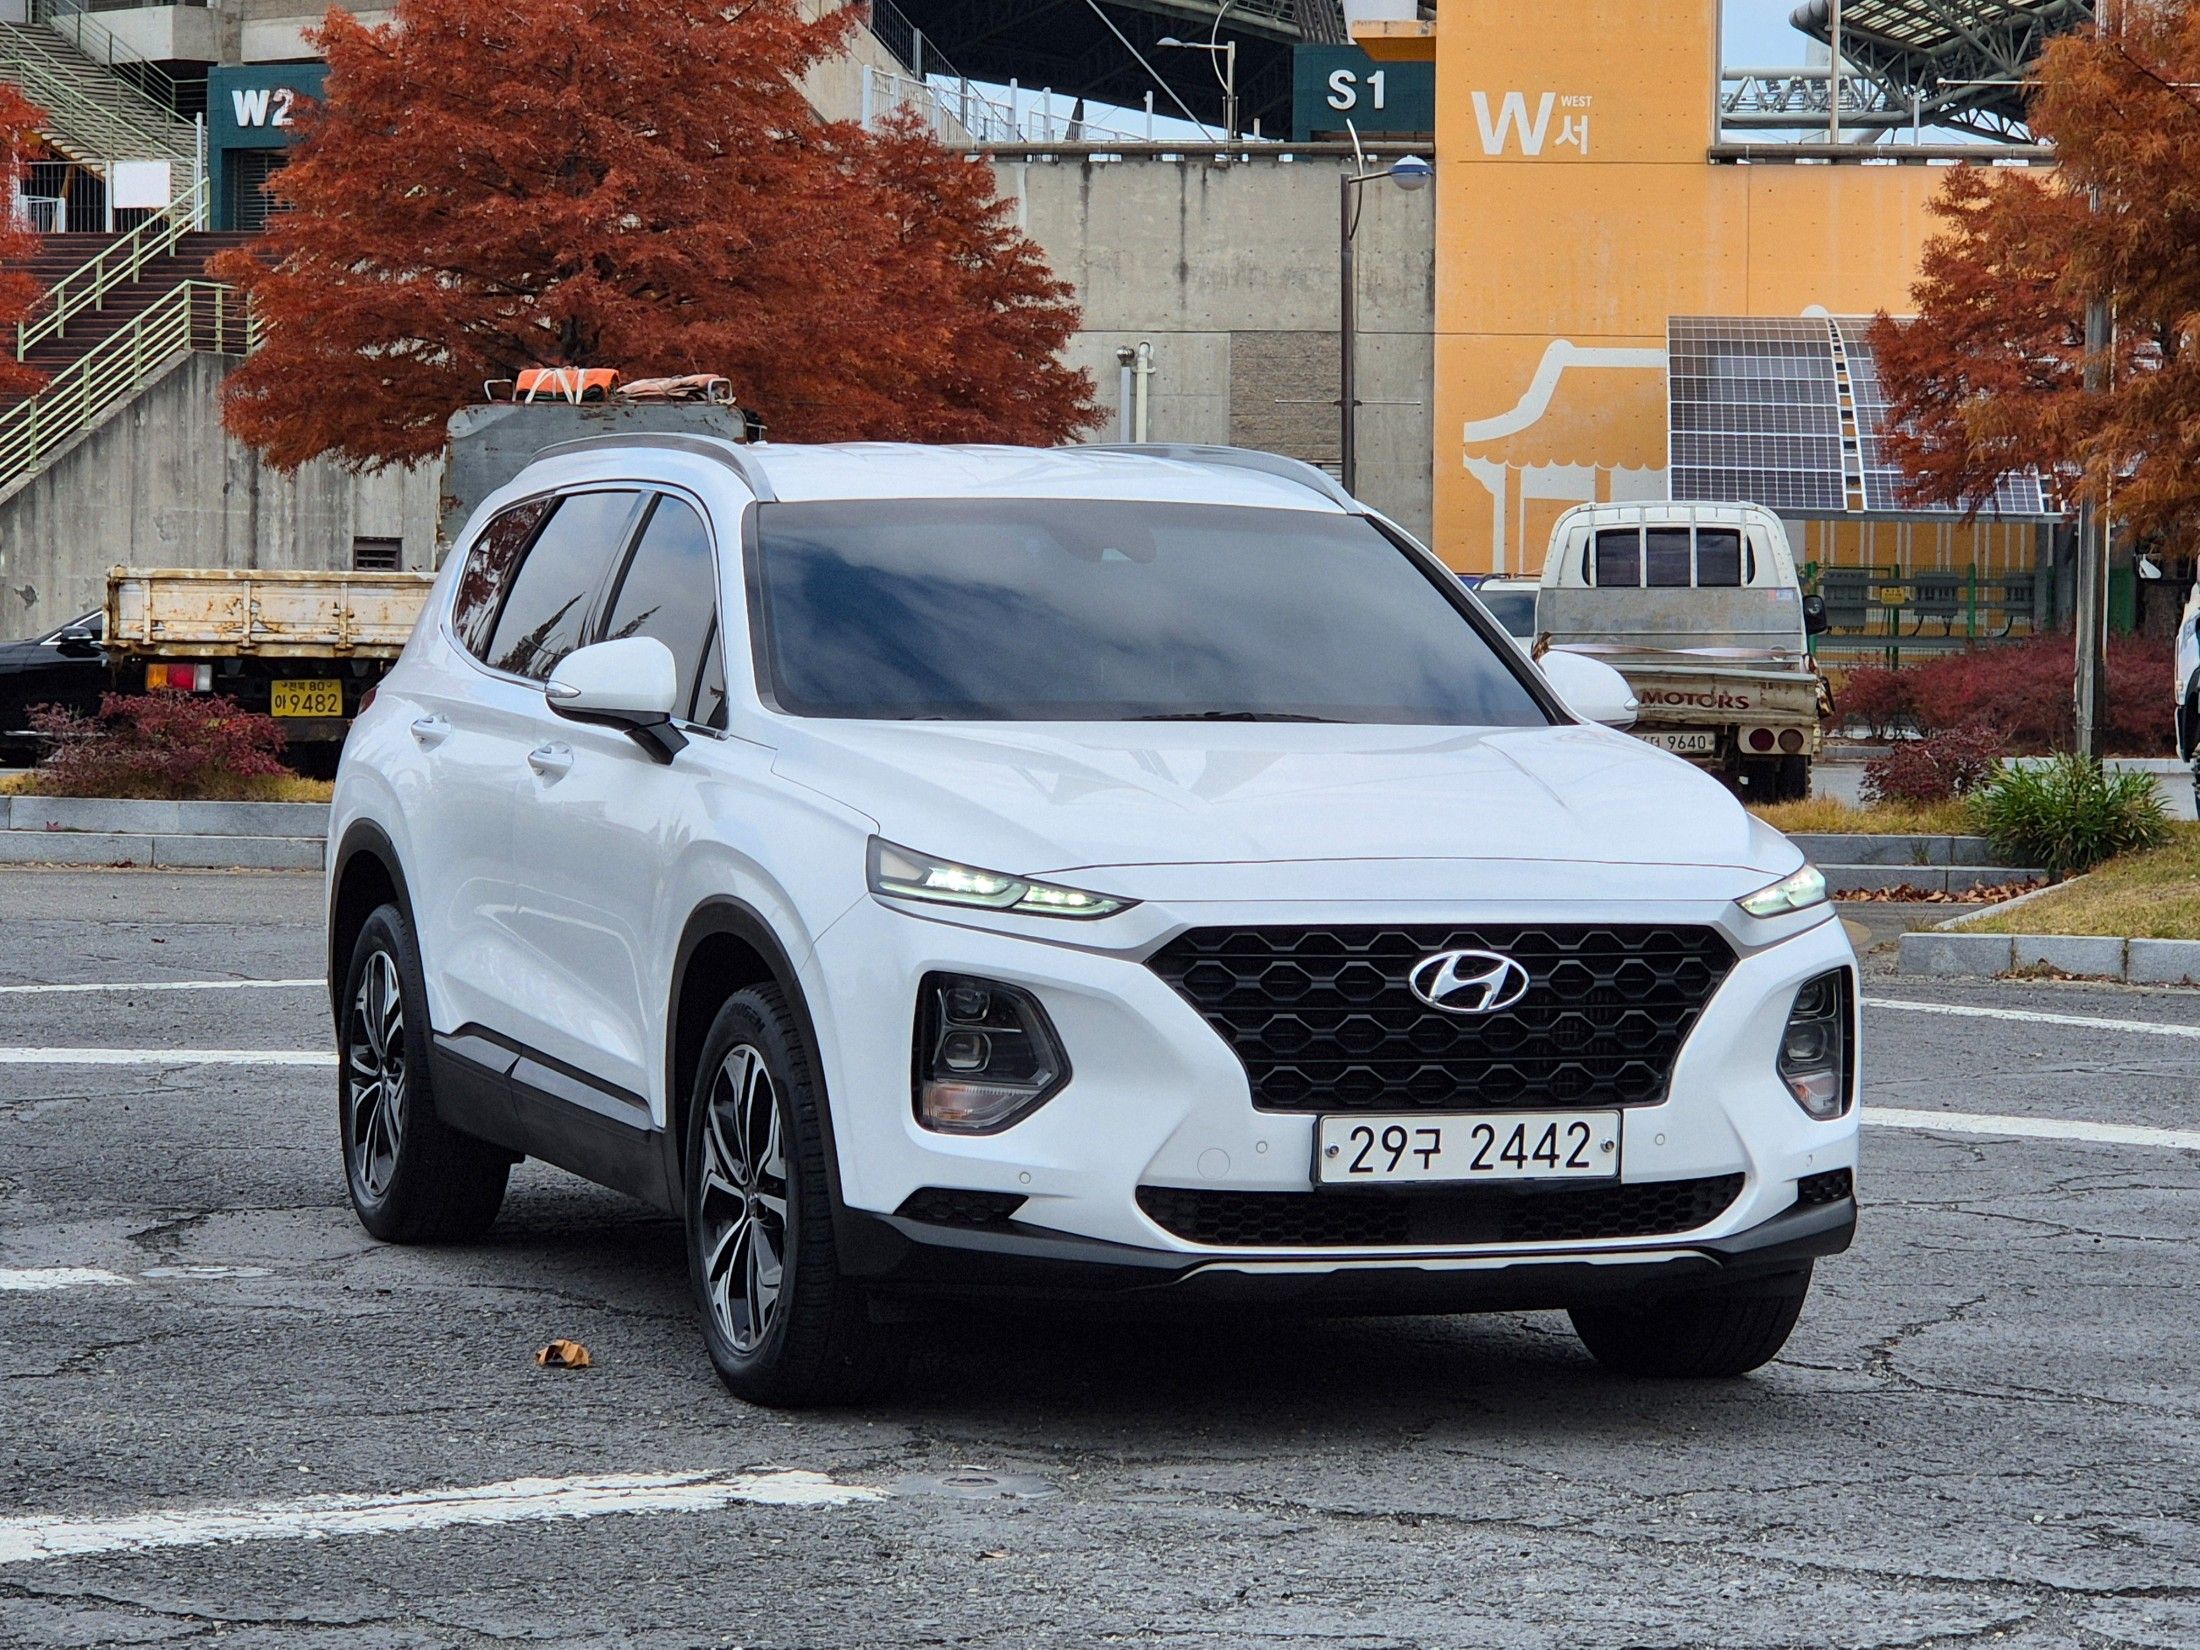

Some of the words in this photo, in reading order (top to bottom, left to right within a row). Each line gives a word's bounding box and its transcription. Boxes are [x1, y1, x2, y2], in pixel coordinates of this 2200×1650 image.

[231, 88, 294, 126] W2
[1327, 69, 1384, 110] S1
[1561, 95, 1592, 107] WEST
[1471, 91, 1556, 155] W
[1554, 115, 1588, 155] 서
[309, 682, 325, 691] 80
[1641, 690, 1750, 709] MOTORS
[1667, 735, 1706, 749] 9640
[1350, 1125, 1441, 1173] 29구
[1470, 1121, 1591, 1170] 2442
